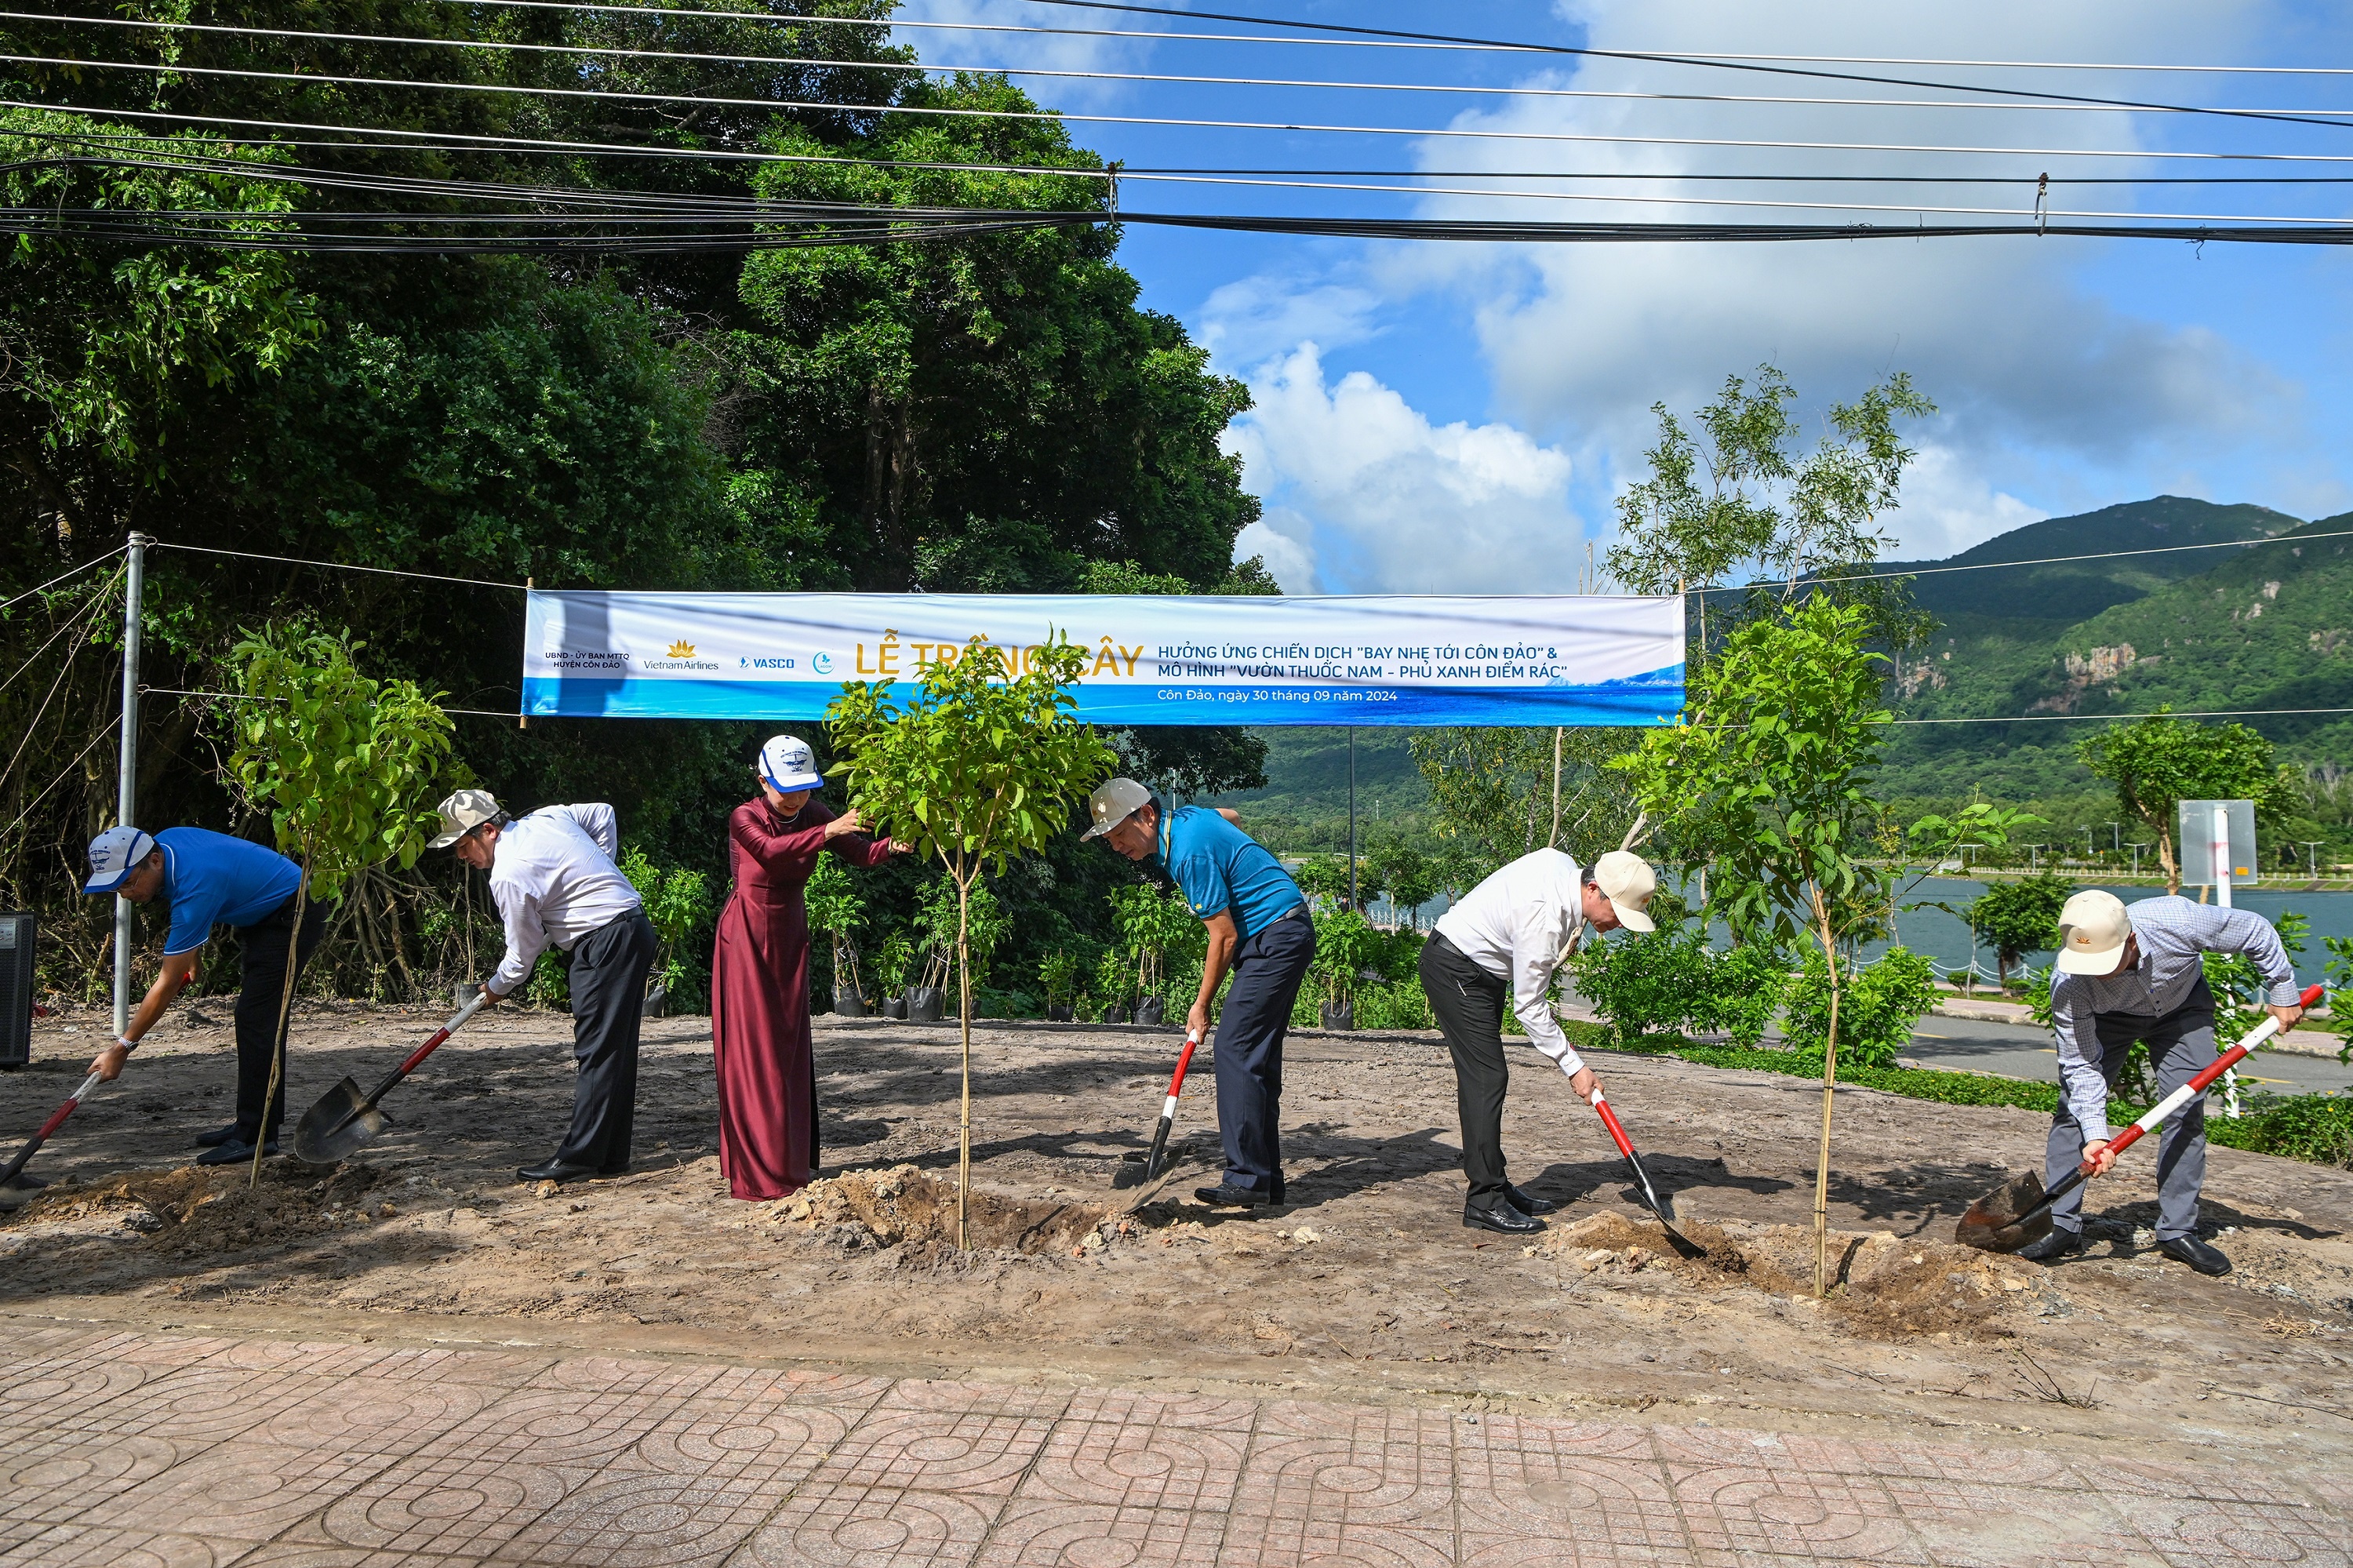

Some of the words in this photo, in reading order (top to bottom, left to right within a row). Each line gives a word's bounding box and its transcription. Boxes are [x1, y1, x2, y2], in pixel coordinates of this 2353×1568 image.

[575, 650, 587, 659] ỦY
[856, 628, 900, 675] LỄ
[1158, 641, 1217, 658] HƯỞNG
[1222, 642, 1257, 658] ỨNG
[1262, 642, 1309, 659] CHIẾN
[1315, 646, 1351, 661] DỊCH
[1398, 647, 1430, 662] NHẸ
[1434, 643, 1460, 659] TỚI
[1464, 643, 1498, 659] CÔN
[1547, 647, 1558, 659] &
[553, 660, 581, 669] HUYỆN
[754, 658, 795, 668] VASCO
[1158, 661, 1182, 677] MÔ
[1187, 661, 1225, 677] HÌNH
[1289, 661, 1342, 678] THUỐC
[1347, 665, 1383, 678] NAM
[1399, 660, 1432, 678] PHỦ
[1436, 665, 1481, 678] XANH
[1486, 660, 1524, 678] ĐIỂM
[1158, 689, 1182, 700] Côn
[1186, 689, 1215, 702] Đảo,
[1218, 689, 1249, 703] ngày
[1253, 690, 1268, 700] 30
[1271, 689, 1310, 703] tháng
[1313, 690, 1330, 700] 09
[1333, 689, 1362, 700] năm
[1366, 690, 1398, 701] 2024
